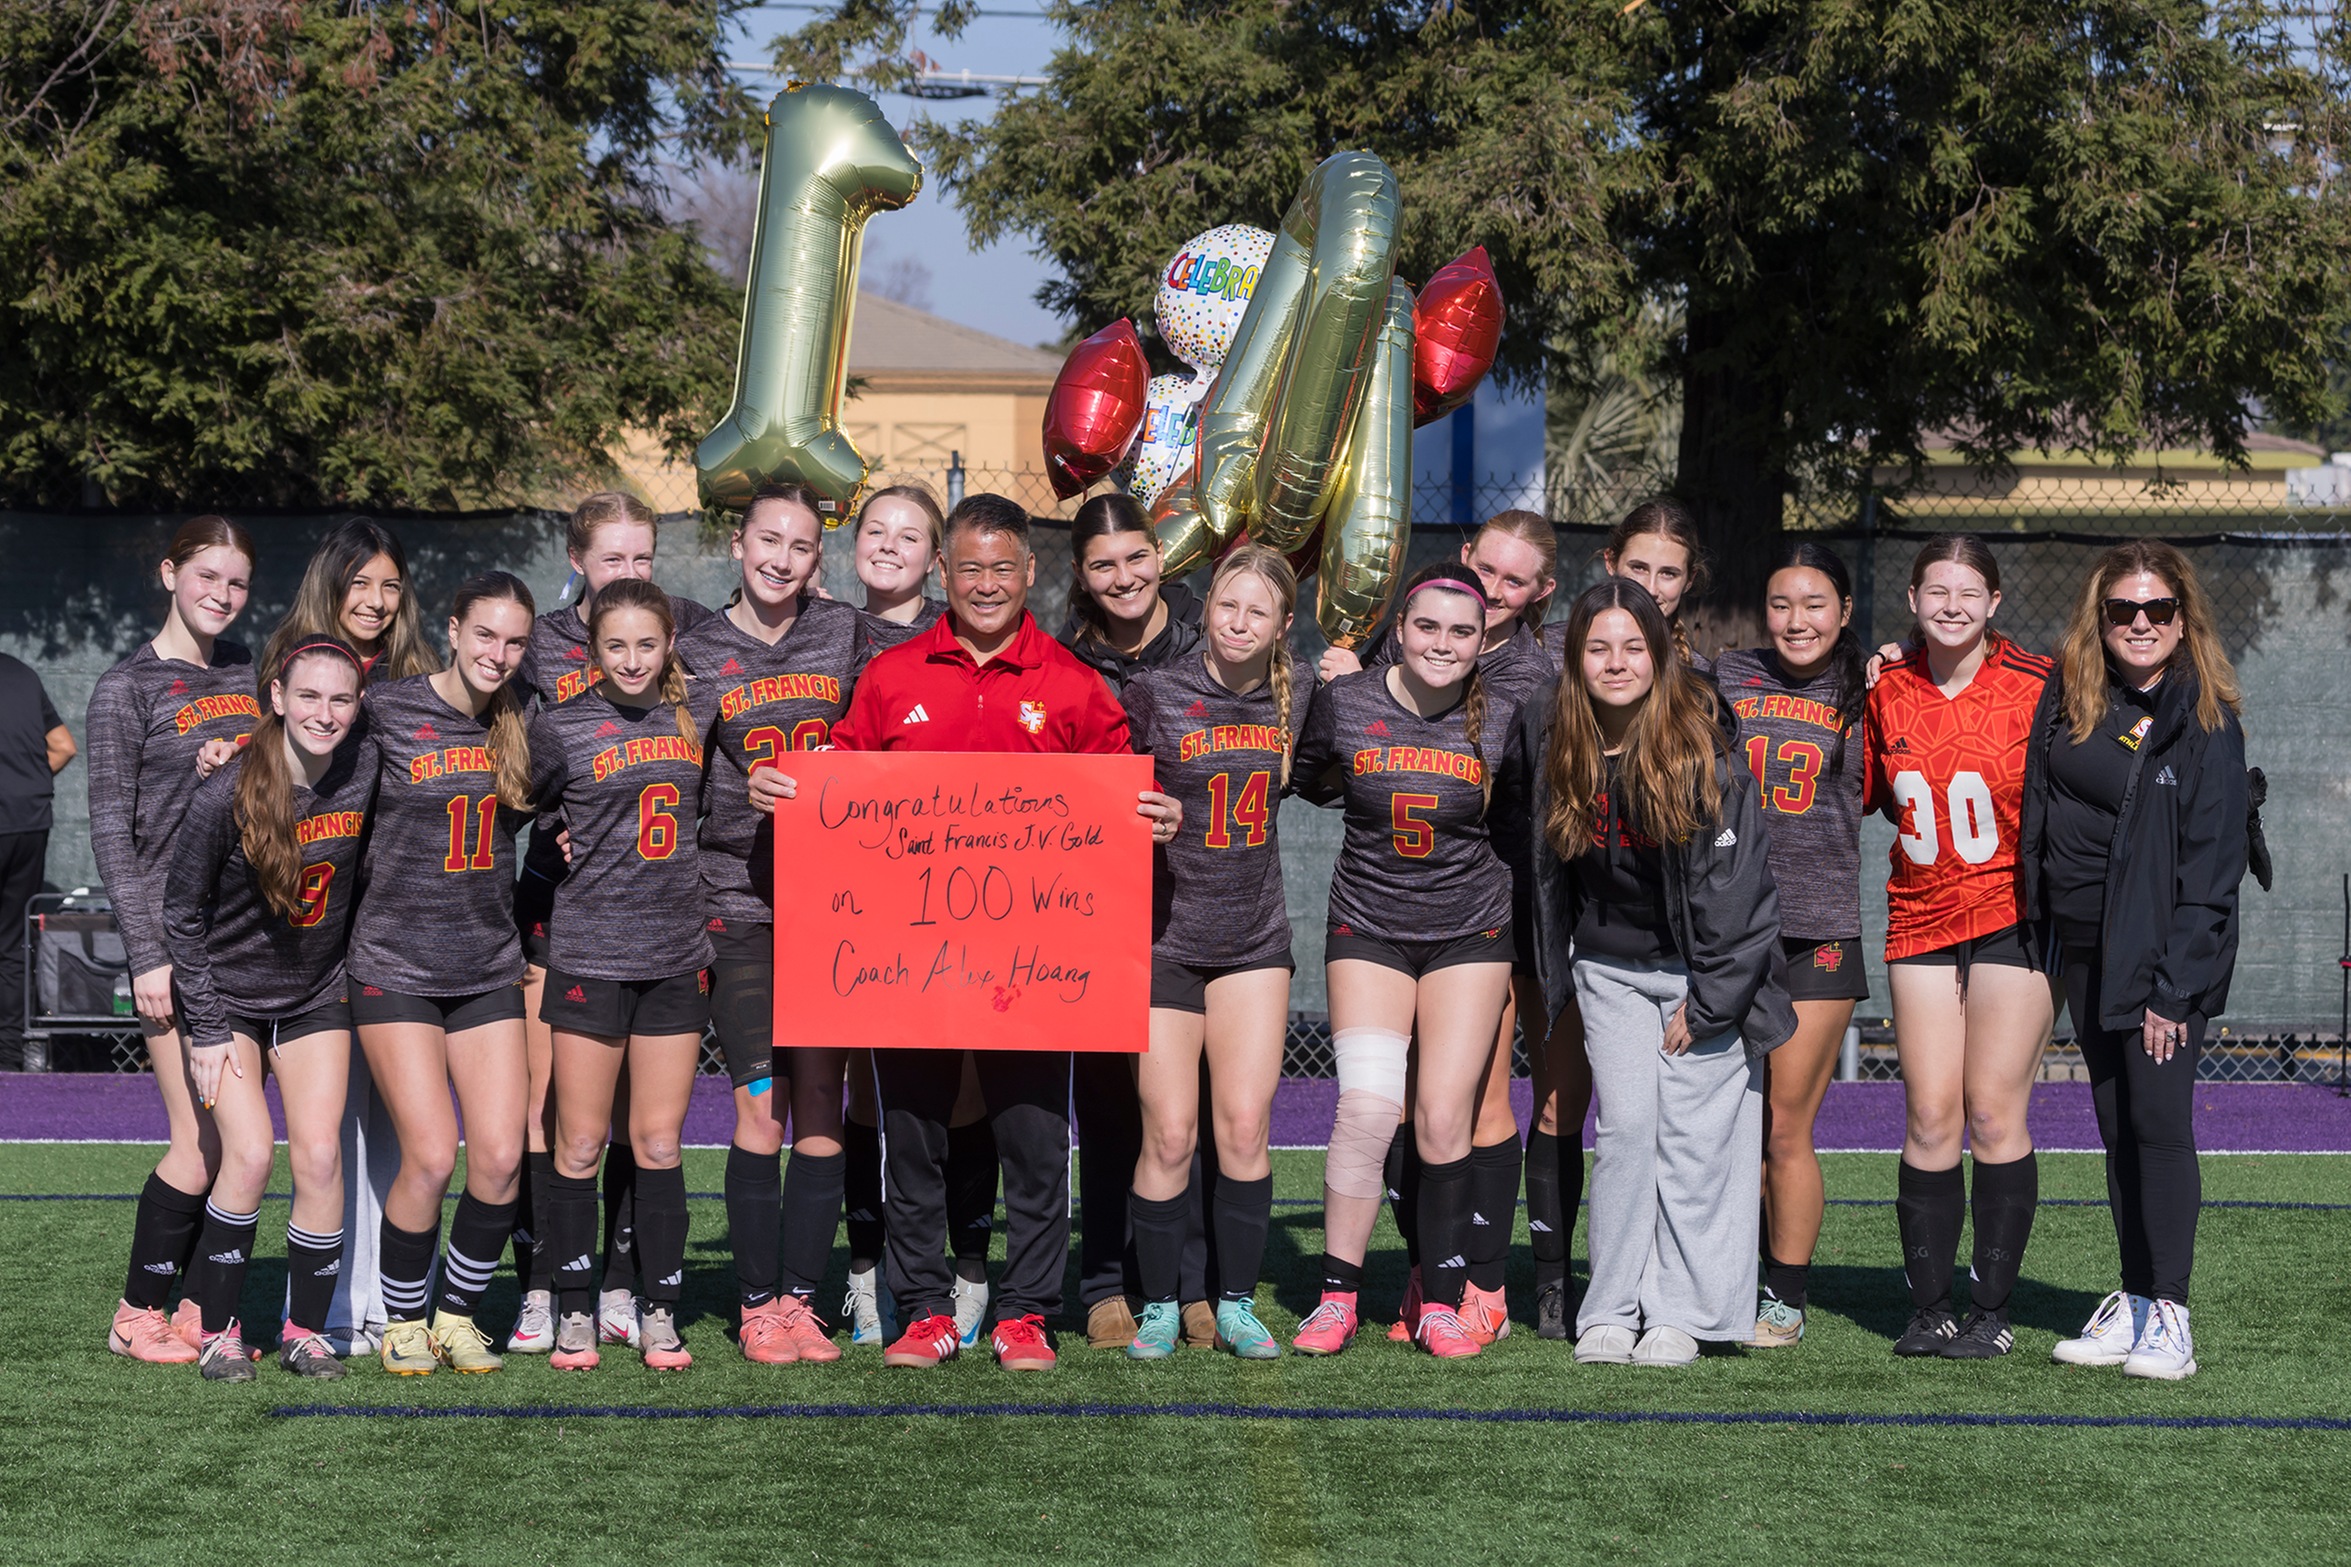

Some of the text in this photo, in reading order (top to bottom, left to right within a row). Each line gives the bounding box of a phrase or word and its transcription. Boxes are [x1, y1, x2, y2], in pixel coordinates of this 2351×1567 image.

[556, 669, 587, 703] ST.
[721, 673, 841, 722] ST. FRANCIS
[175, 704, 203, 736] ST.
[1181, 729, 1210, 762] ST.
[410, 752, 442, 784] ST.
[592, 746, 625, 782] ST.
[1354, 747, 1482, 785] ST. FRANCIS
[1745, 735, 1824, 814] 13
[444, 795, 497, 872] 11
[637, 783, 680, 861] 6
[819, 776, 1069, 849] Congratulations
[886, 827, 935, 860] Saint
[945, 823, 1009, 853] Francis
[1060, 821, 1104, 851] Gold
[1205, 771, 1271, 848] 14
[1391, 792, 1439, 858] 5
[1893, 770, 2000, 865] 30
[287, 861, 336, 928] 9
[832, 865, 1094, 926] on 100 Wins
[832, 940, 1091, 1003] Coach Alex Hoang
